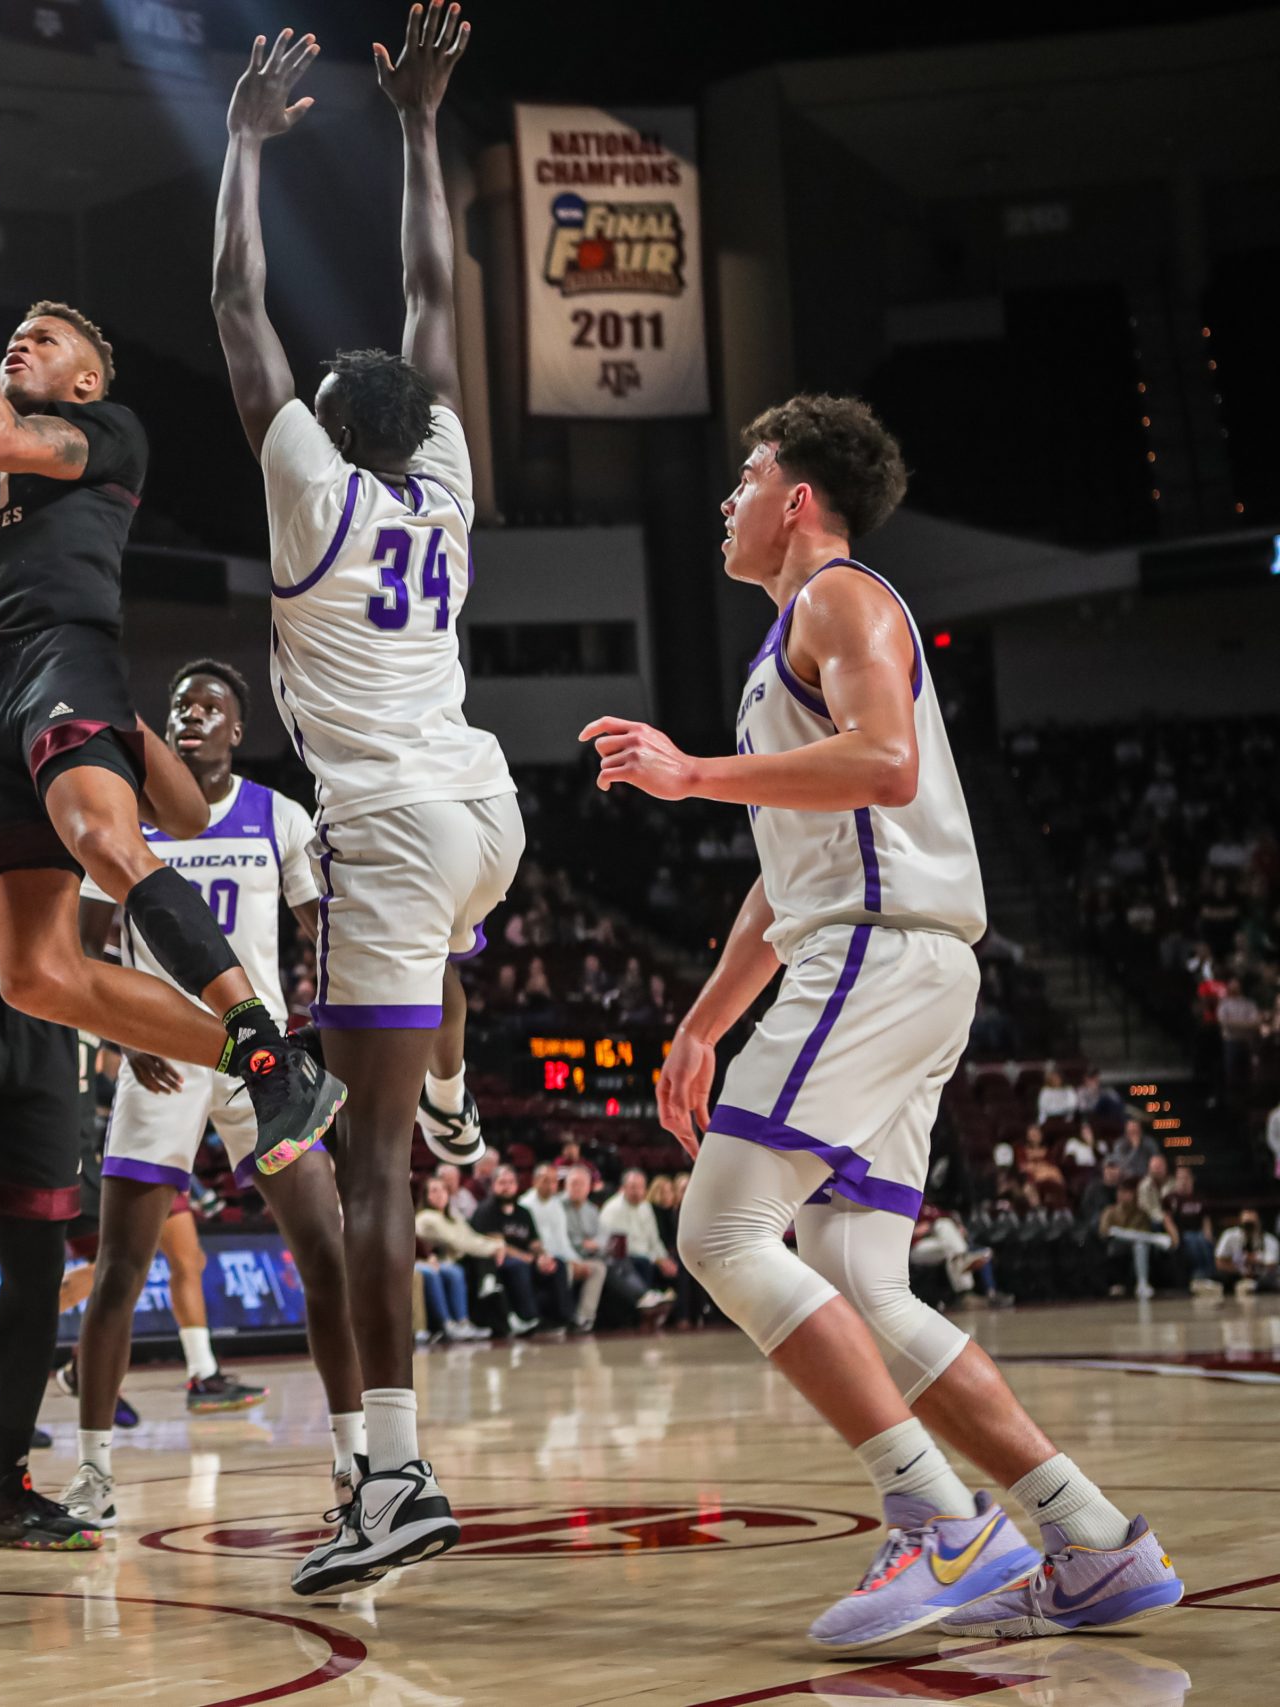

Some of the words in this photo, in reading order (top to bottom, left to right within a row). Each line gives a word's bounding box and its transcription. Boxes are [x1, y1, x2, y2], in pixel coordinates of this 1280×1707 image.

[550, 130, 664, 156] NATIONAL
[535, 158, 681, 187] CHAMPIONS
[584, 206, 674, 239] FINAL
[570, 308, 665, 351] 2011
[365, 526, 451, 631] 34
